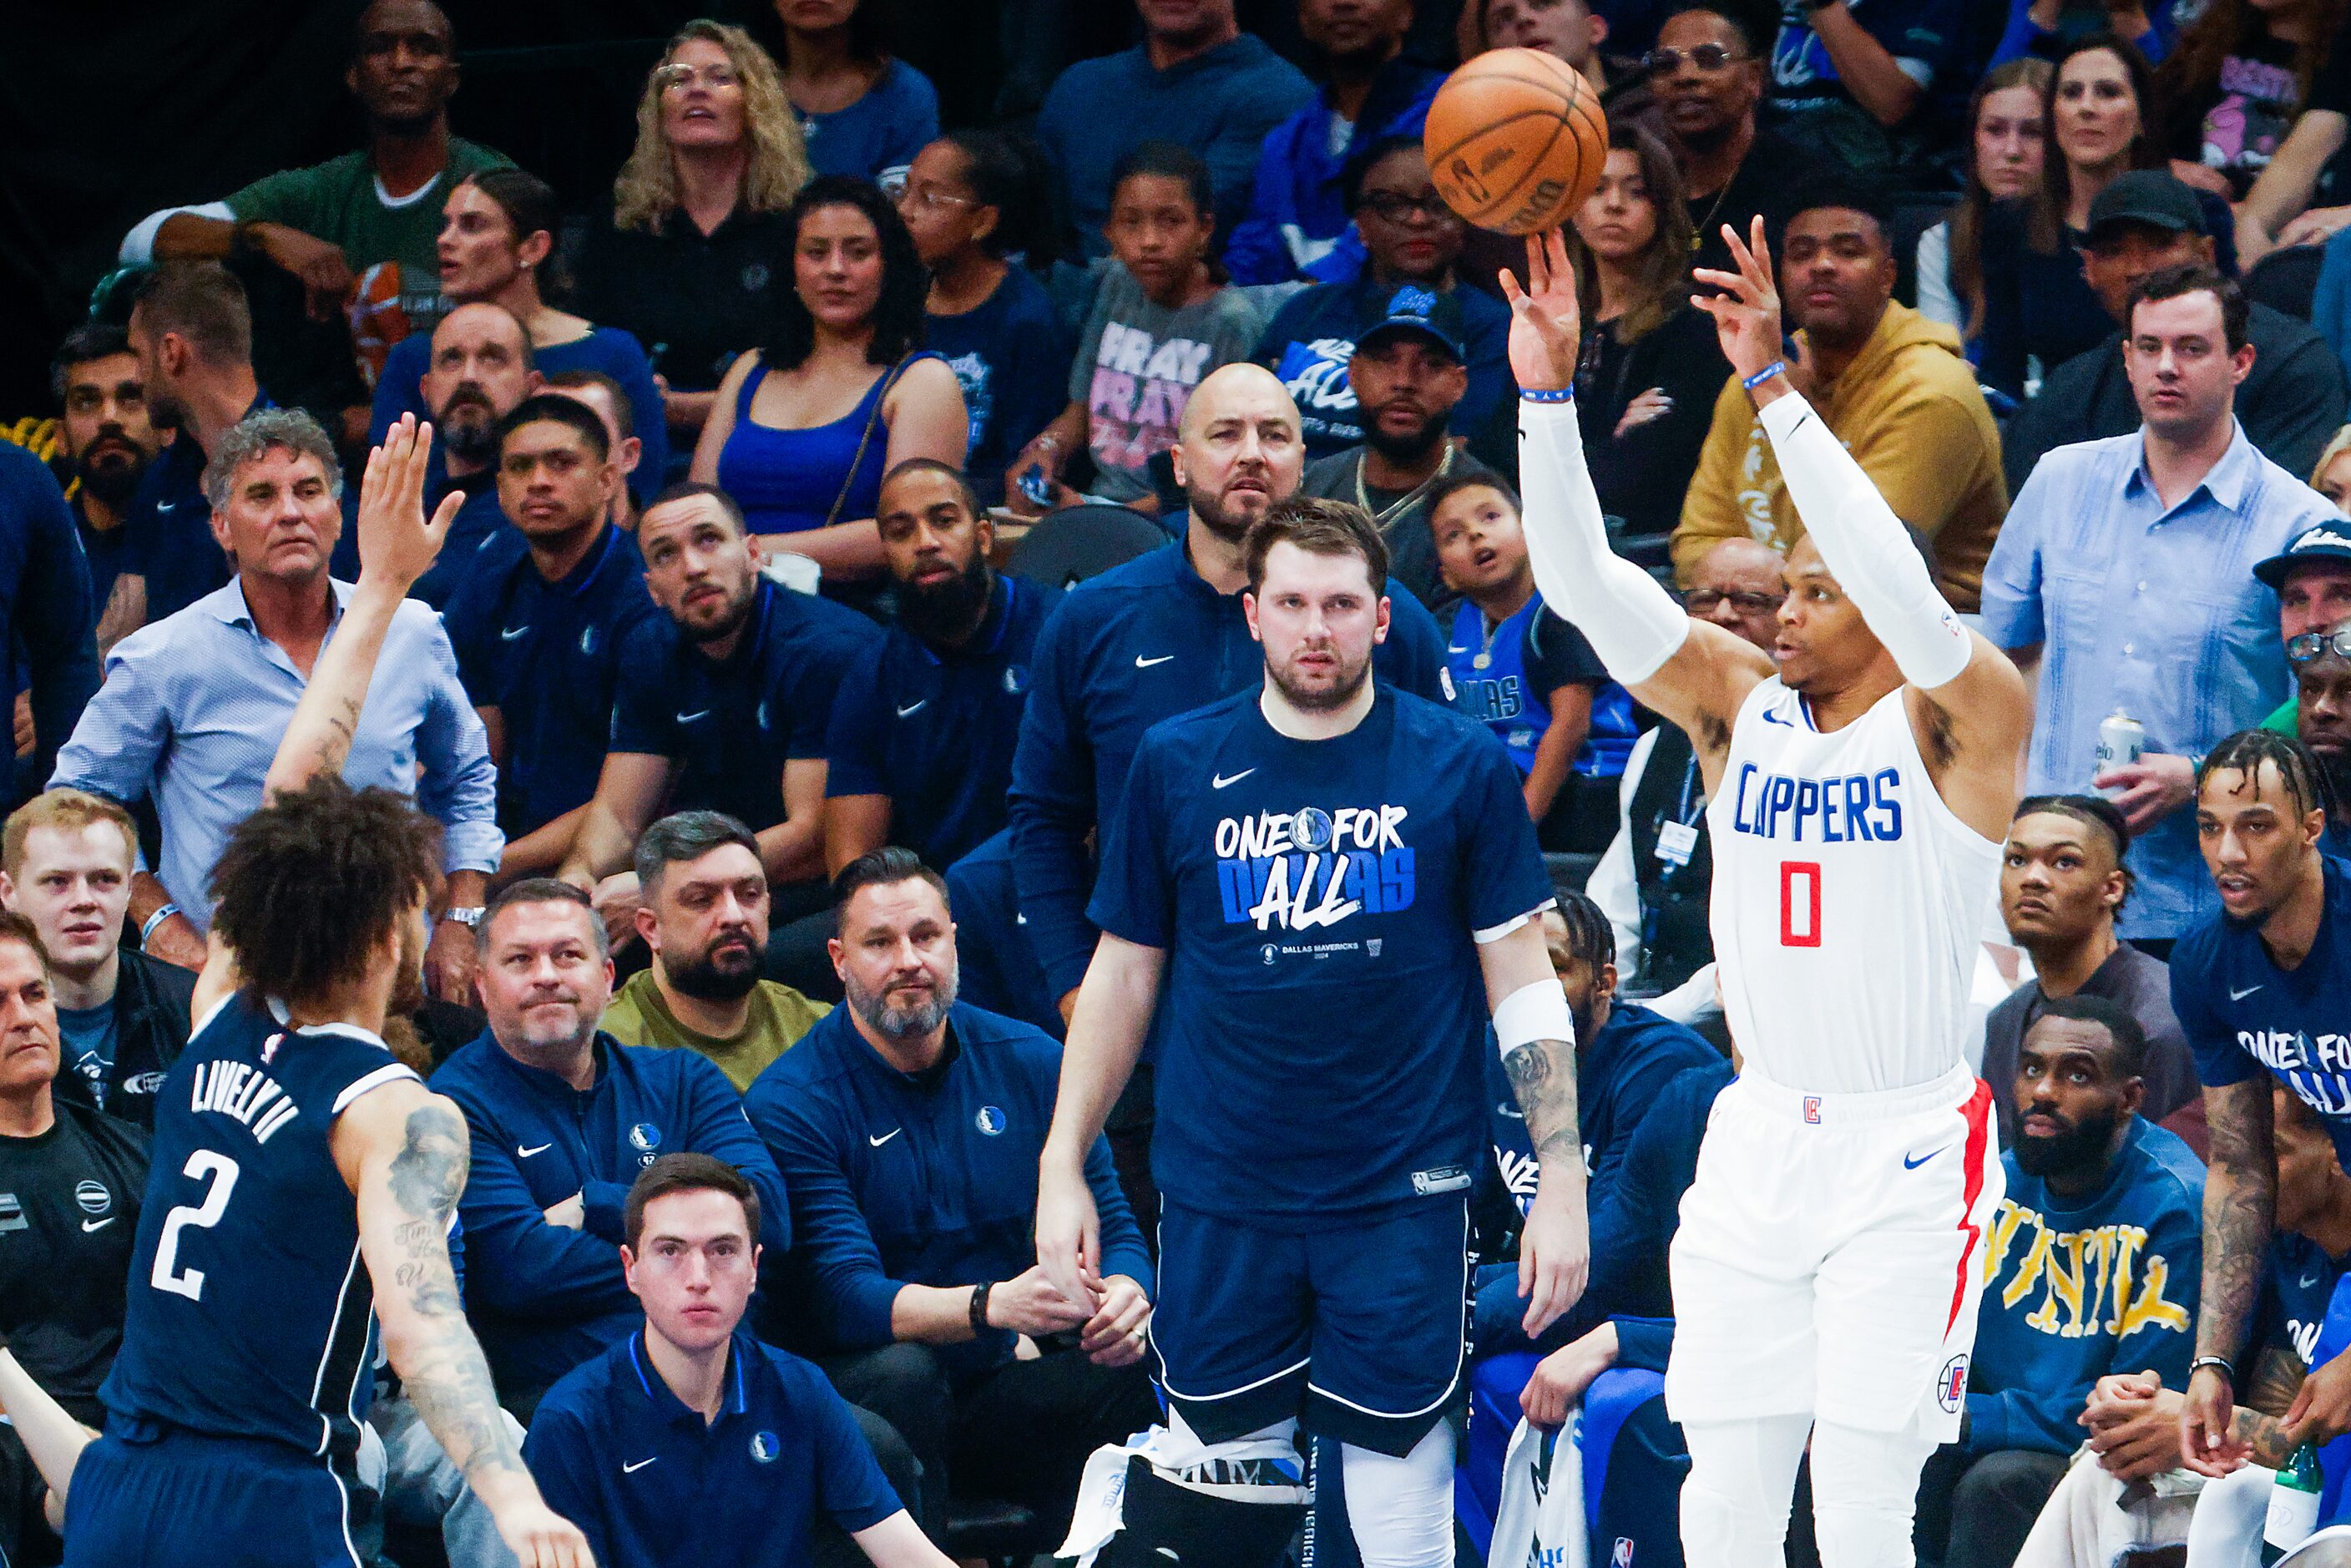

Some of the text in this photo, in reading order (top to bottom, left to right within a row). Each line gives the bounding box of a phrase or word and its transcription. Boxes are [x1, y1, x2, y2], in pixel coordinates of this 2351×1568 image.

[1215, 803, 1408, 861] ONE FOR
[1248, 851, 1363, 931] ALL
[1780, 860, 1821, 948] 0
[1282, 942, 1359, 954] DALLAS MAVERICKS
[2237, 1026, 2351, 1074] ONE FO
[191, 1059, 300, 1145] LIVELY II
[1494, 1145, 1540, 1194] NE
[150, 1149, 240, 1302] 2
